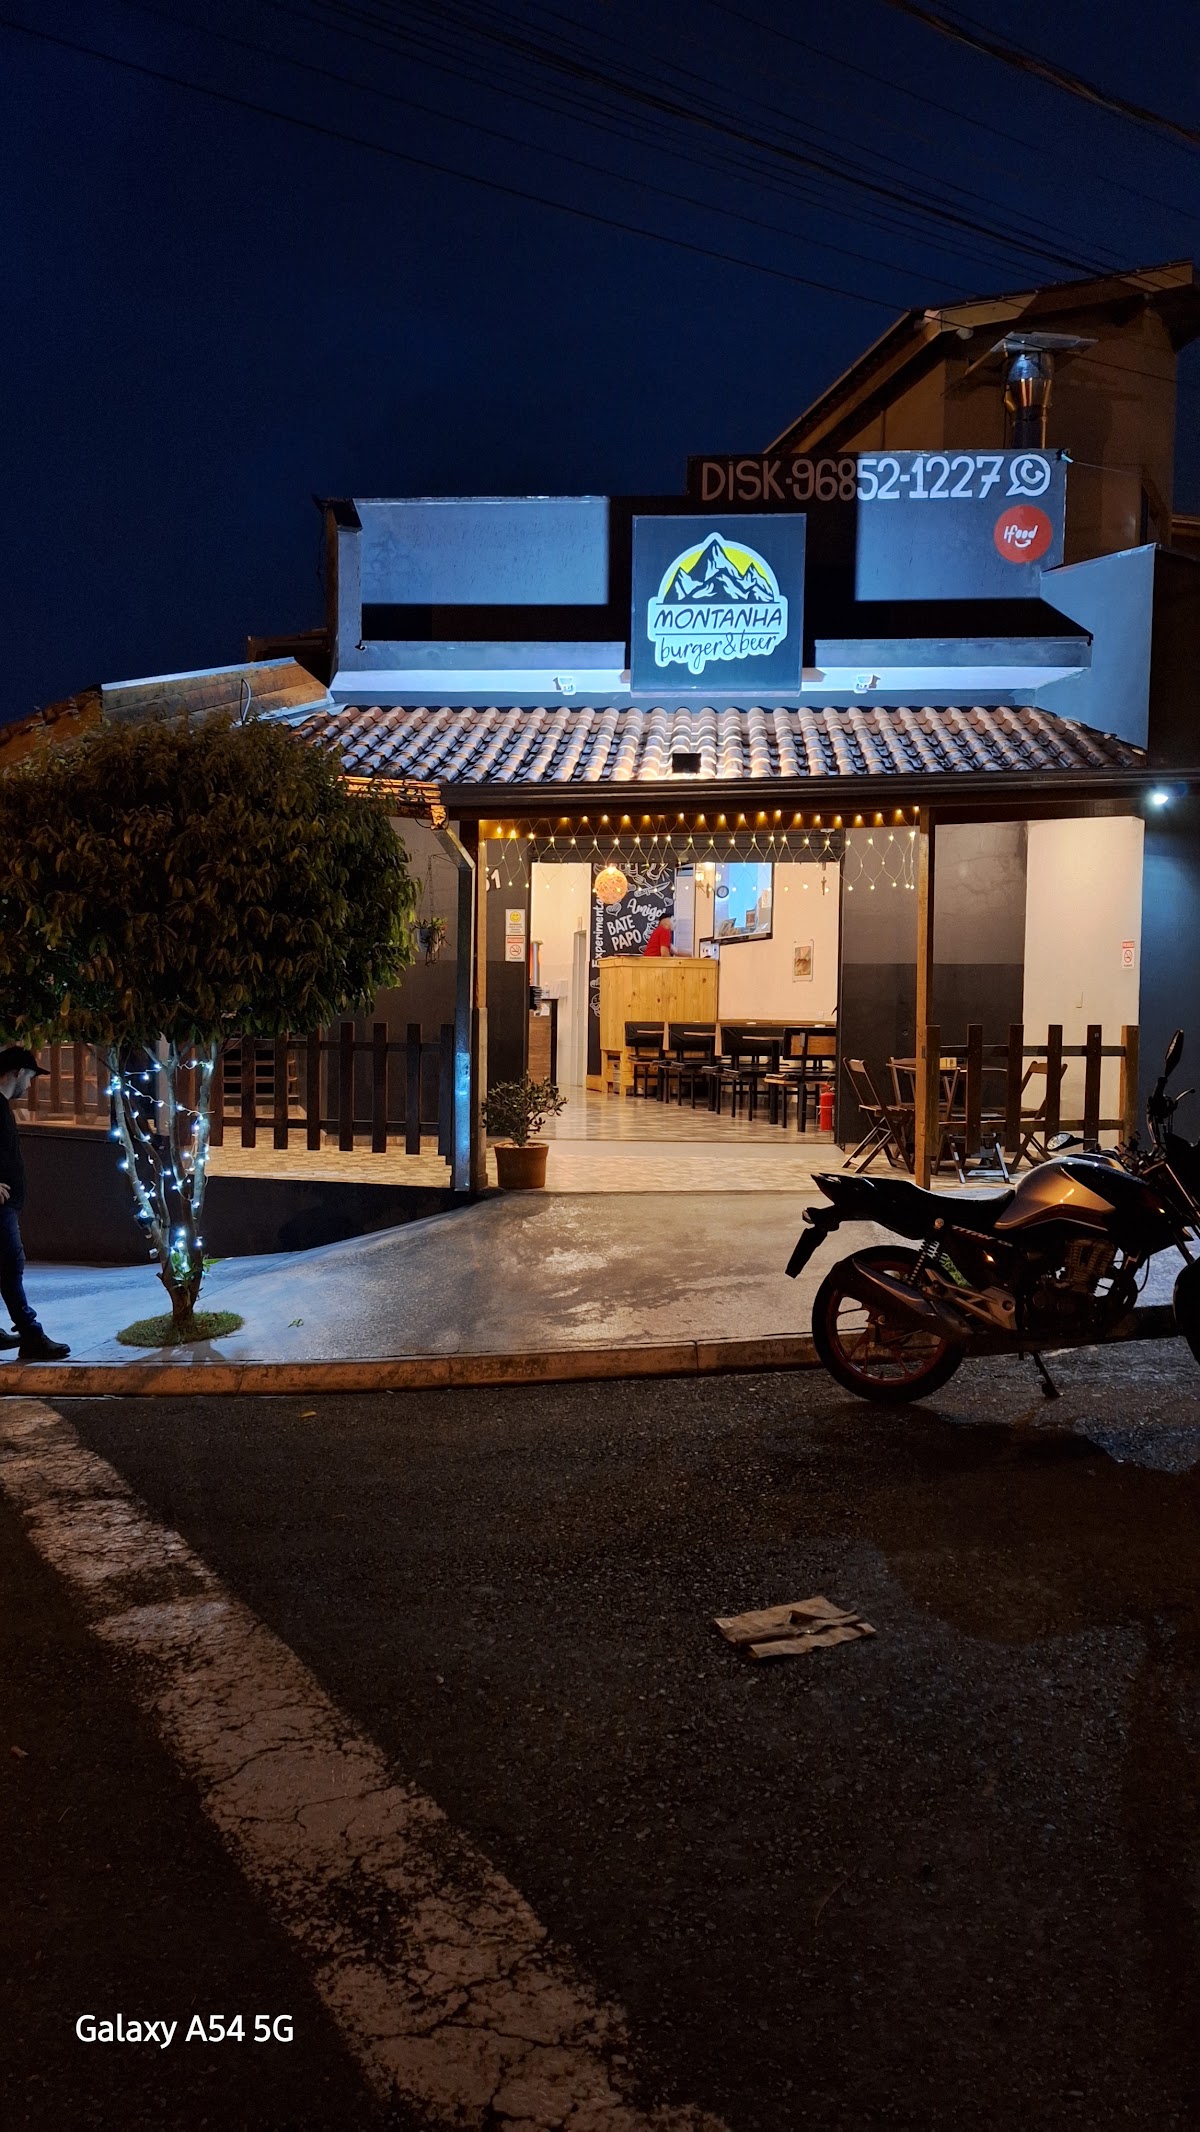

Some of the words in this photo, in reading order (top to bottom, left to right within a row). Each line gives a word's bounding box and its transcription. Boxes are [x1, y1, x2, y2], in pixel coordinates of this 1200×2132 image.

[653, 606, 783, 629] MONTANHA
[606, 914, 636, 936] BATE
[611, 929, 642, 952] PAPO
